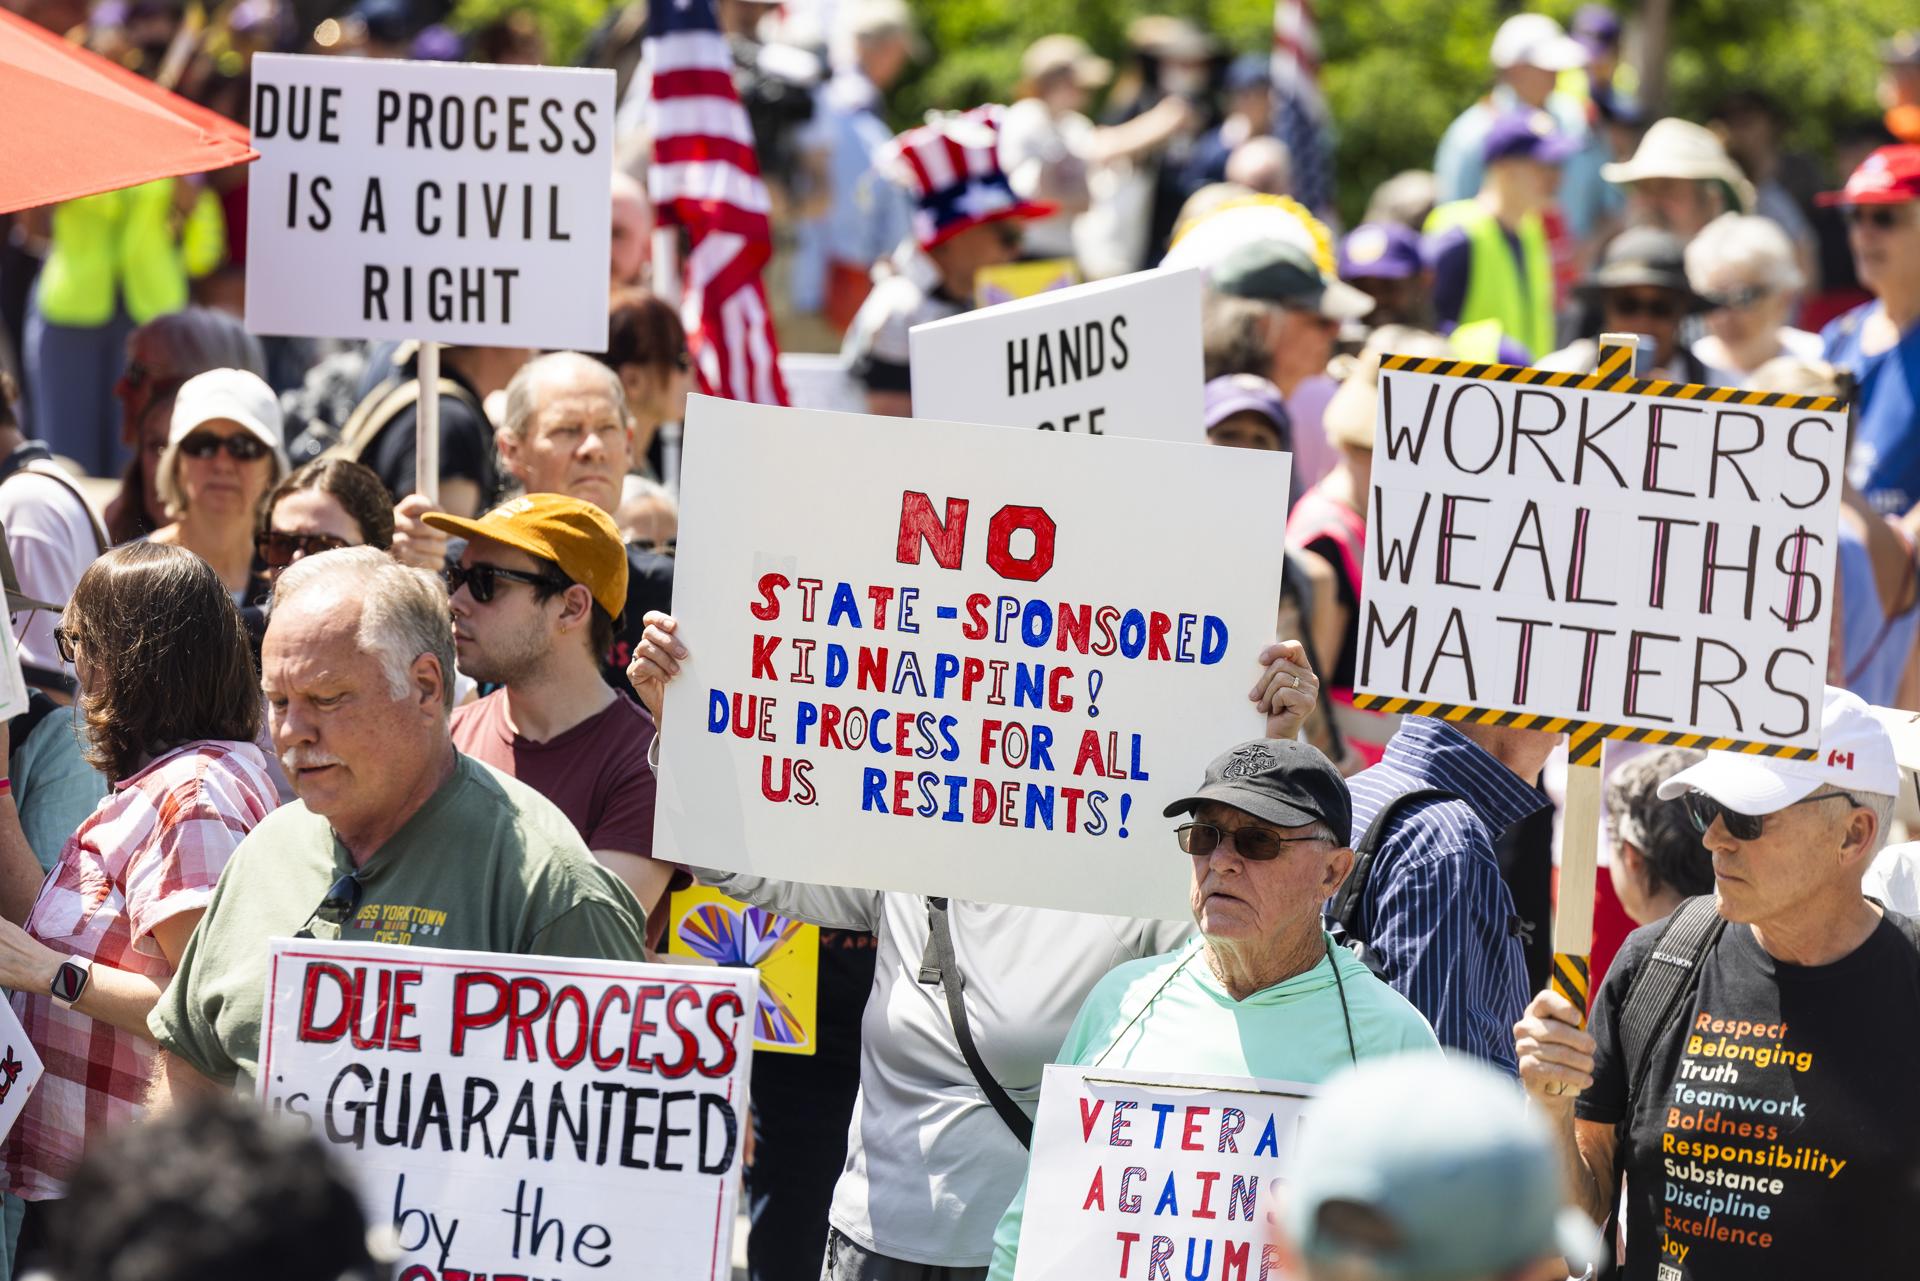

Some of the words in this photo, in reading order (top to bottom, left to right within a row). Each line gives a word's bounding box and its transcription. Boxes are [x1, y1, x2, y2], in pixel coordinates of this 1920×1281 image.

[255, 83, 342, 143] DUE
[376, 89, 597, 154] PROCESS
[287, 172, 332, 231] IS
[359, 176, 387, 233] A
[416, 181, 571, 241] CIVIL
[363, 264, 519, 324] RIGHT
[1007, 315, 1129, 397] HANDS
[1383, 376, 1834, 509] WORKERS
[896, 489, 1057, 582] NO
[1375, 485, 1824, 632] WEALTH$
[751, 634, 1103, 718] KIDNAPPING!
[1360, 600, 1815, 738] MATTERS
[707, 689, 777, 743] DUE
[796, 702, 959, 762] PROCESS
[980, 719, 1055, 772] FOR
[1073, 730, 1150, 782] ALL
[861, 767, 1132, 838] RESIDENTS!
[381, 905, 447, 927] YORKTOWN
[297, 962, 423, 1051] DUE
[450, 971, 744, 1079] PROCESS
[1695, 1012, 1789, 1040] Respect
[1681, 1059, 1739, 1084] Truth
[1687, 1035, 1813, 1072] Belonging
[272, 1075, 313, 1137] is
[324, 1062, 738, 1175] GUARANTEED
[1079, 1097, 1300, 1158] VETERA
[1666, 1107, 1778, 1141] Boldness
[1675, 1083, 1806, 1117] Teamwork
[1662, 1133, 1847, 1179] Responsibility
[1664, 1157, 1784, 1195] Substance
[393, 1173, 459, 1272] by
[502, 1180, 612, 1267] the
[1664, 1181, 1772, 1220] Discipline
[1664, 1207, 1773, 1248] Excellence
[1661, 1233, 1690, 1264] Joy
